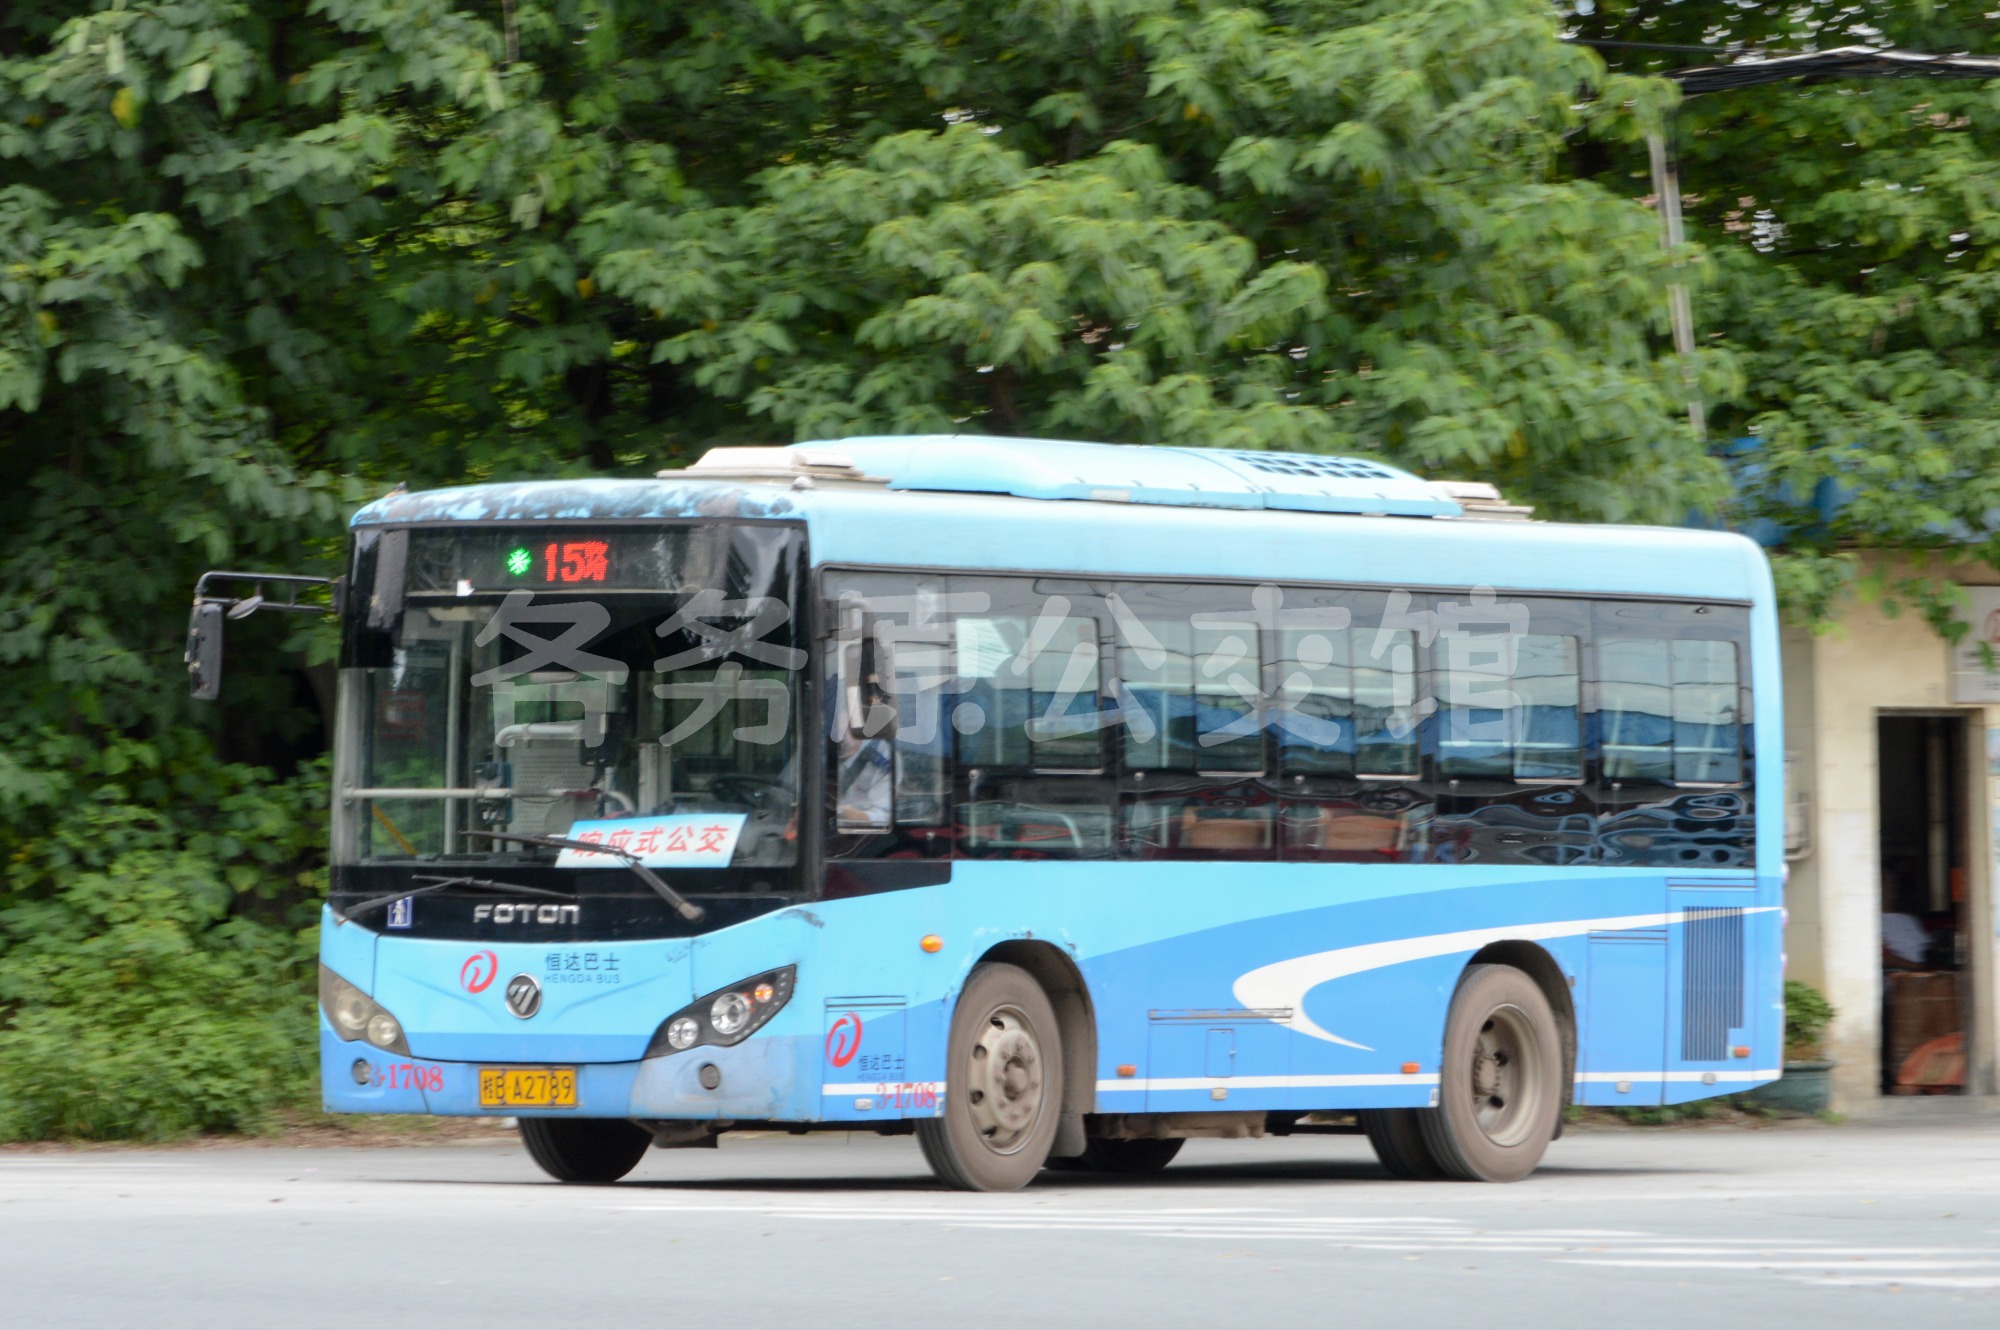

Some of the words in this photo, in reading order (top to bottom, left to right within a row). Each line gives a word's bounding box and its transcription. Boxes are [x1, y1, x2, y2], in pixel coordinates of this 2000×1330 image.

[473, 904, 580, 924] FOTON
[544, 952, 621, 971] 恒达巴士
[543, 974, 592, 984] HENGDA
[596, 974, 621, 984] BUS
[859, 1054, 905, 1070] 恒达巴士
[369, 1063, 445, 1092] 3-1708
[876, 1082, 937, 1109] 3-1708
